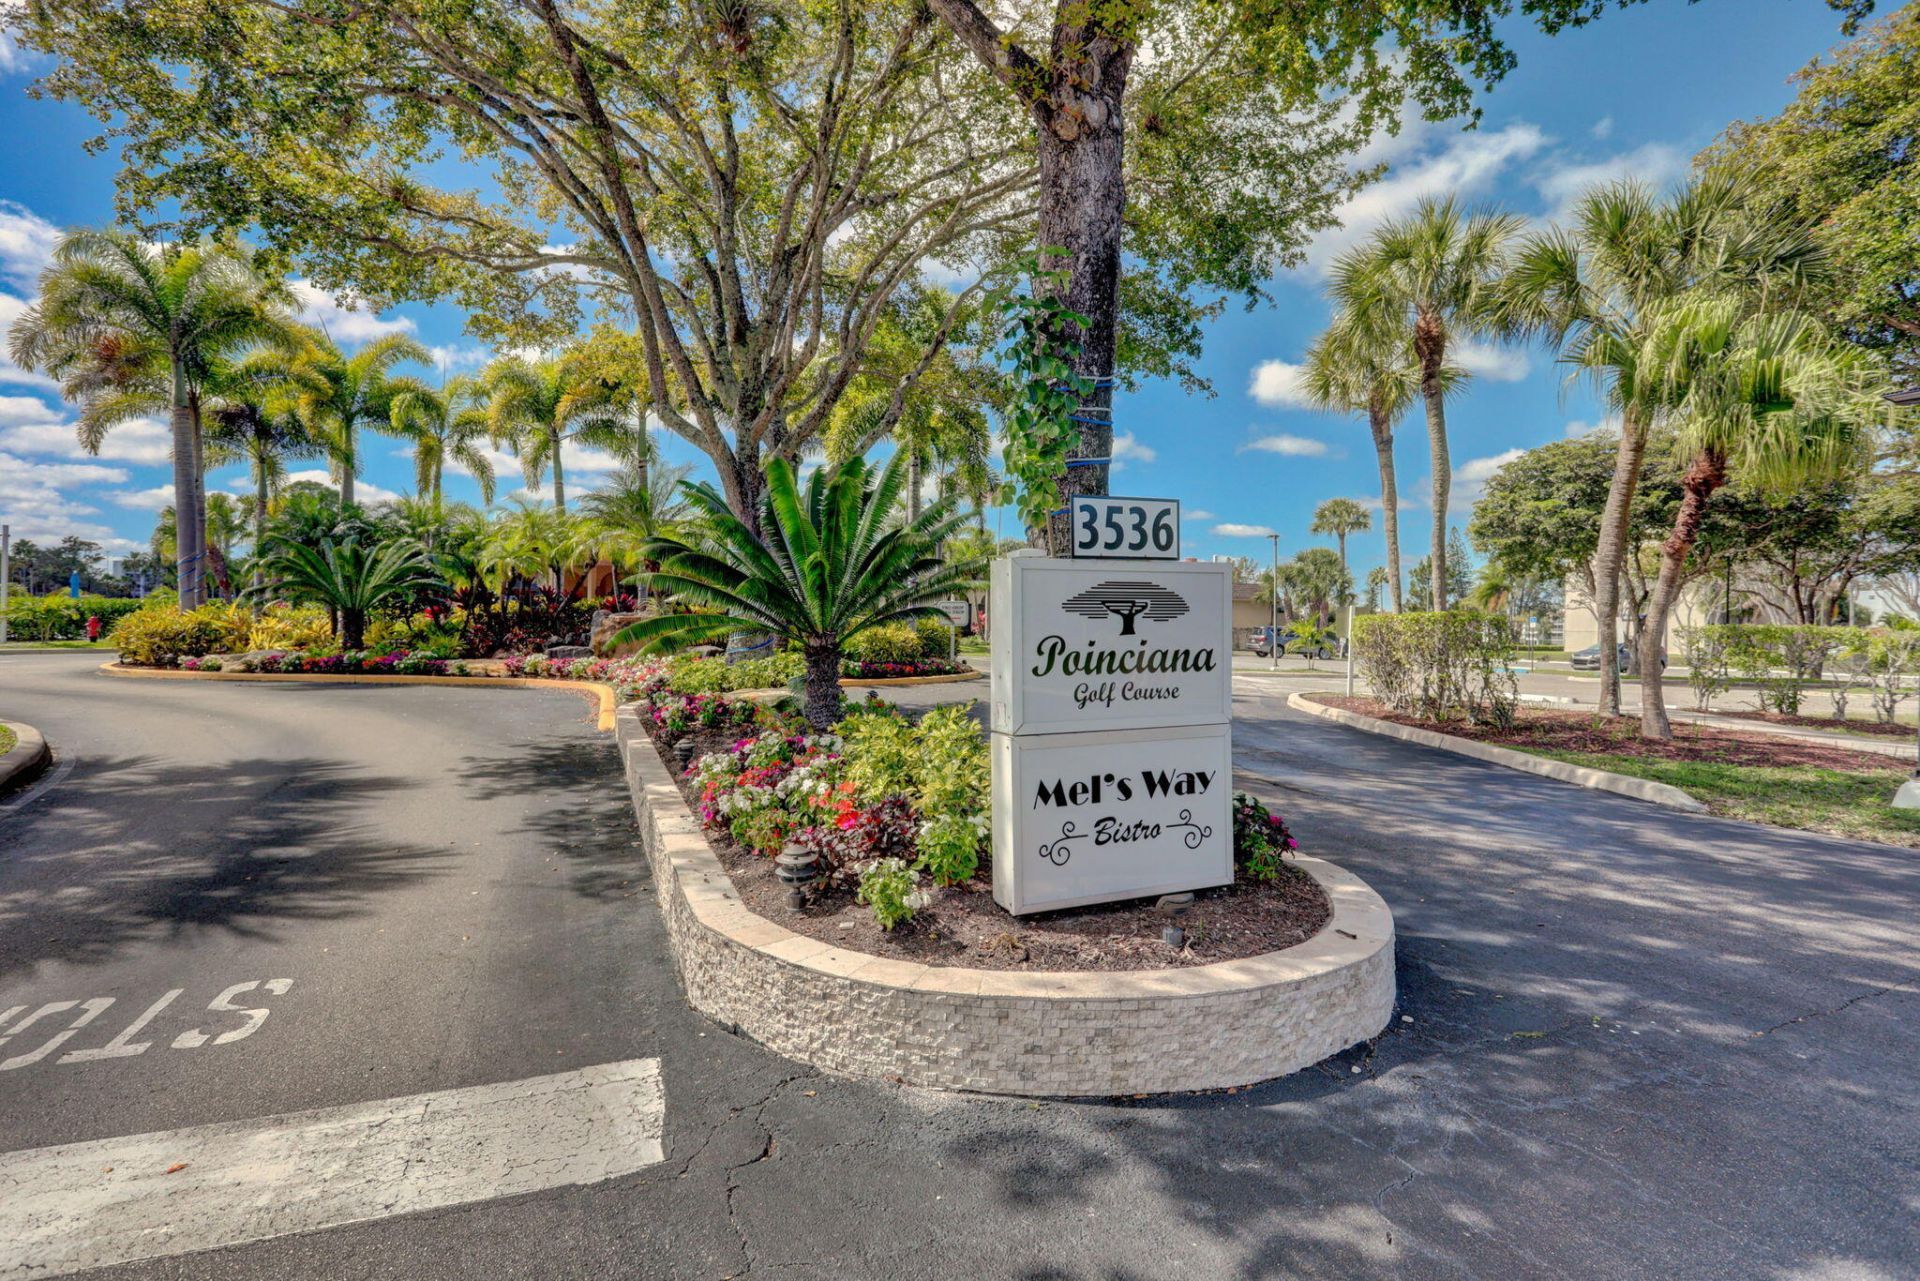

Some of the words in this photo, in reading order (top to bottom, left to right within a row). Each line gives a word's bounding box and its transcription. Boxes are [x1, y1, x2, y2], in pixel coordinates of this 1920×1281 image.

[1078, 504, 1174, 552] 3536
[1032, 635, 1217, 677] Poinciana
[1073, 682, 1117, 710] Golf
[1121, 681, 1181, 702] Course
[1033, 773, 1133, 810] Mel's
[1141, 768, 1217, 800] Way
[1094, 816, 1162, 846] Bistro
[0, 978, 295, 1071] STO
